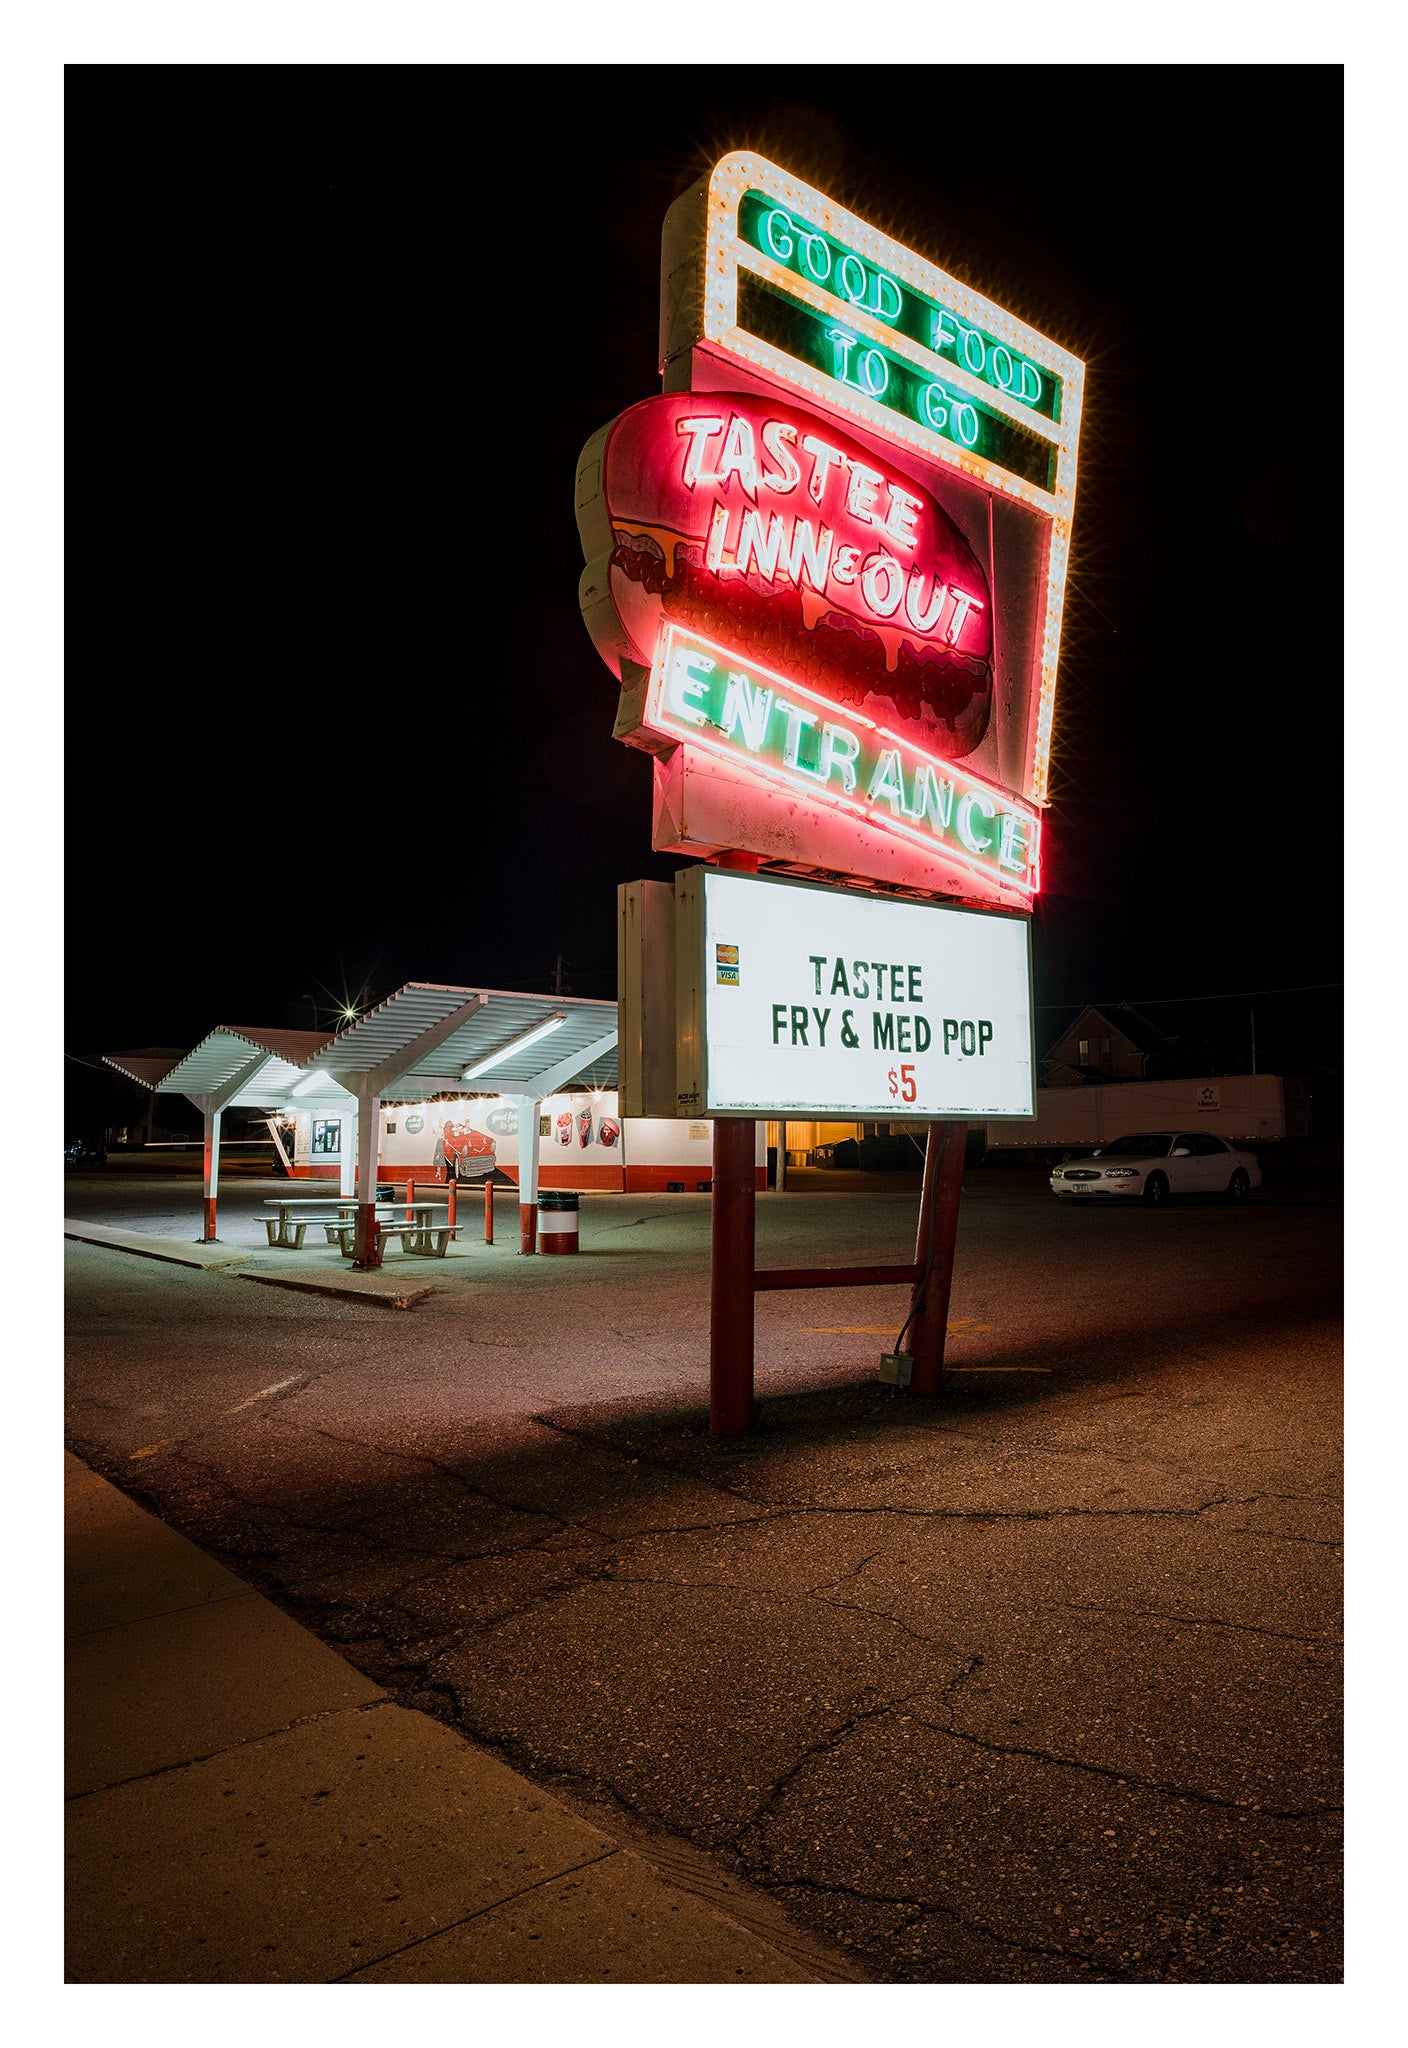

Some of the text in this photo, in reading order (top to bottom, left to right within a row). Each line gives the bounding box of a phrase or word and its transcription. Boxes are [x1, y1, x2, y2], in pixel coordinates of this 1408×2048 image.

[759, 209, 1042, 405] GOOD FOOD
[827, 329, 979, 447] TO GO
[678, 413, 924, 550] TASTEE
[669, 647, 1028, 872] ENTRANCE
[720, 970, 737, 980] VISA
[808, 955, 923, 1003] TASTEE
[771, 1003, 994, 1057] FRY & MED POP
[888, 1064, 917, 1103] $5
